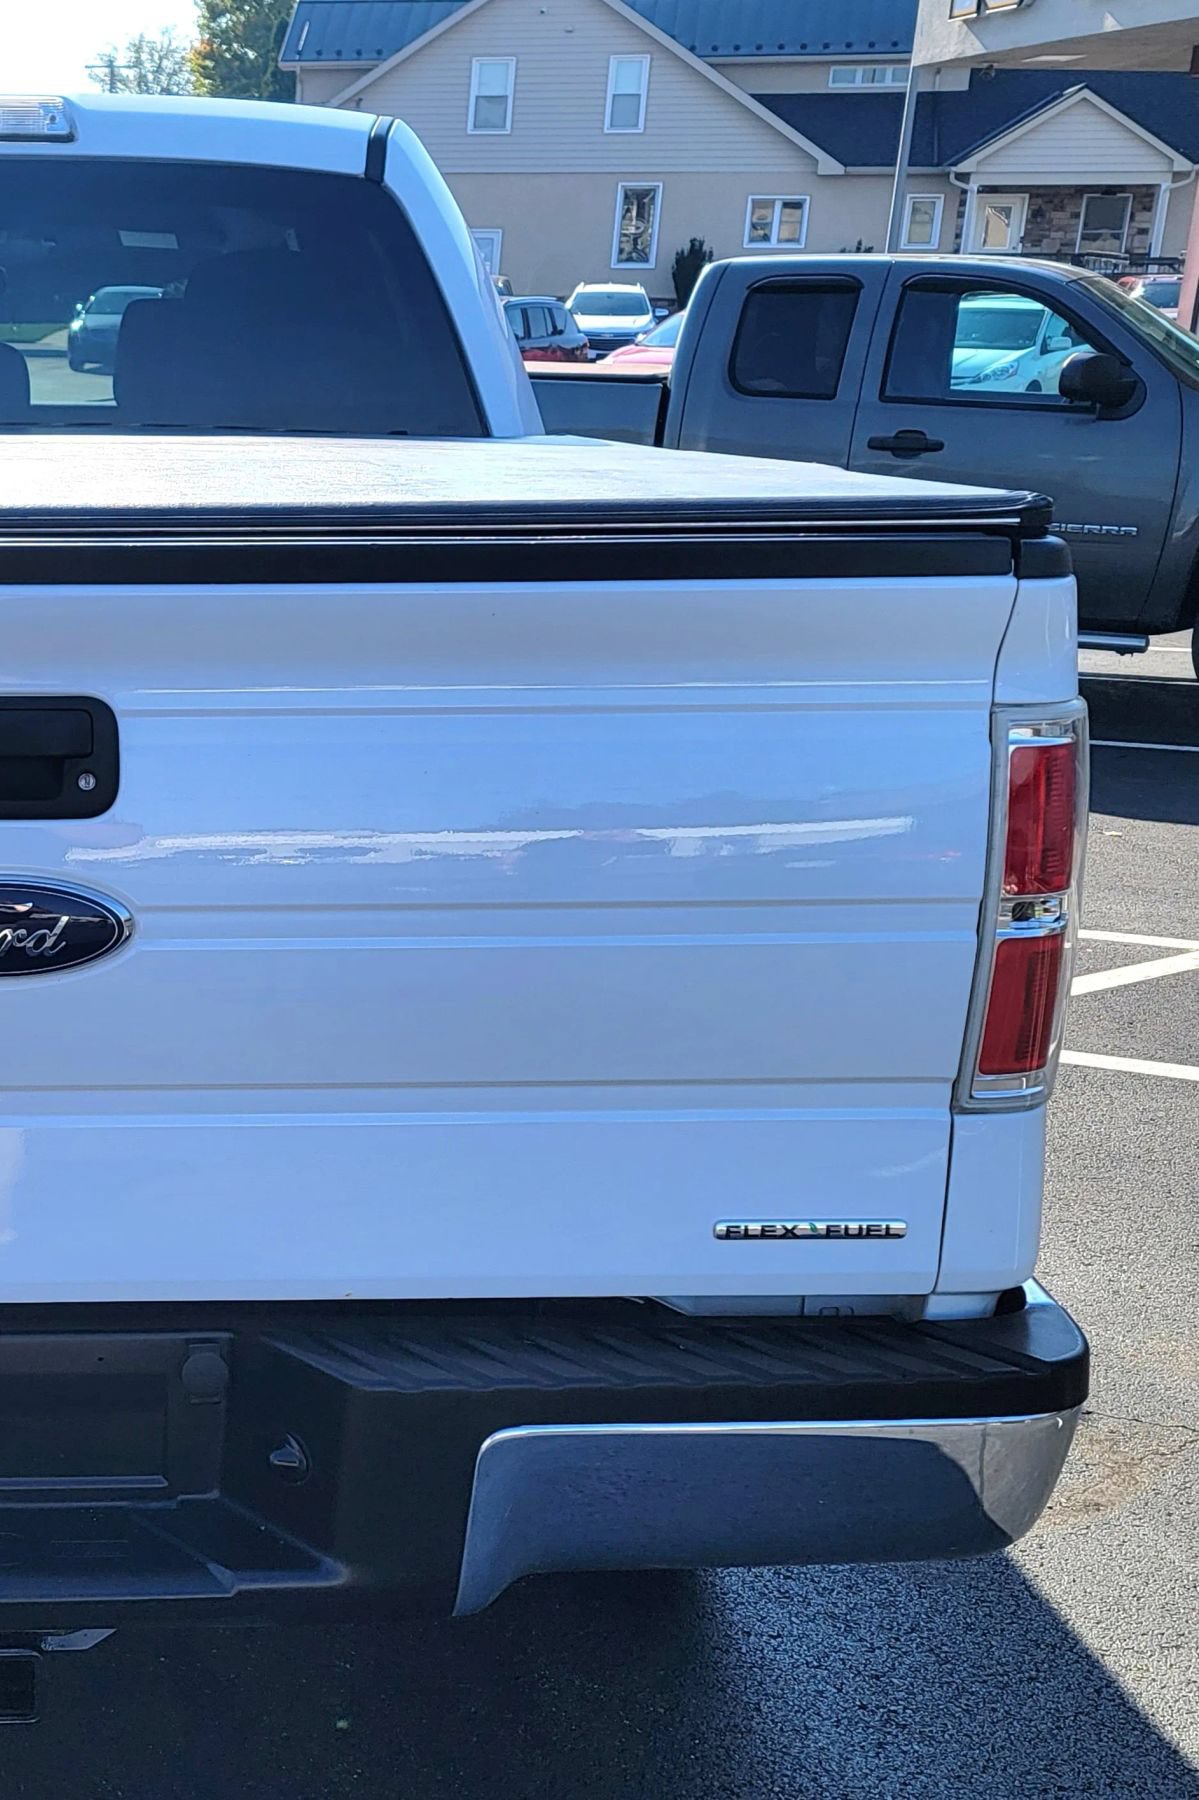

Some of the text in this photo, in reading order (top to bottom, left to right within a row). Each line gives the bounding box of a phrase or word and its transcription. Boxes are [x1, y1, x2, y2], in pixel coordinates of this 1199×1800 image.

[1047, 522, 1138, 536] SIERRA
[724, 1223, 901, 1239] FLEX FUEL
